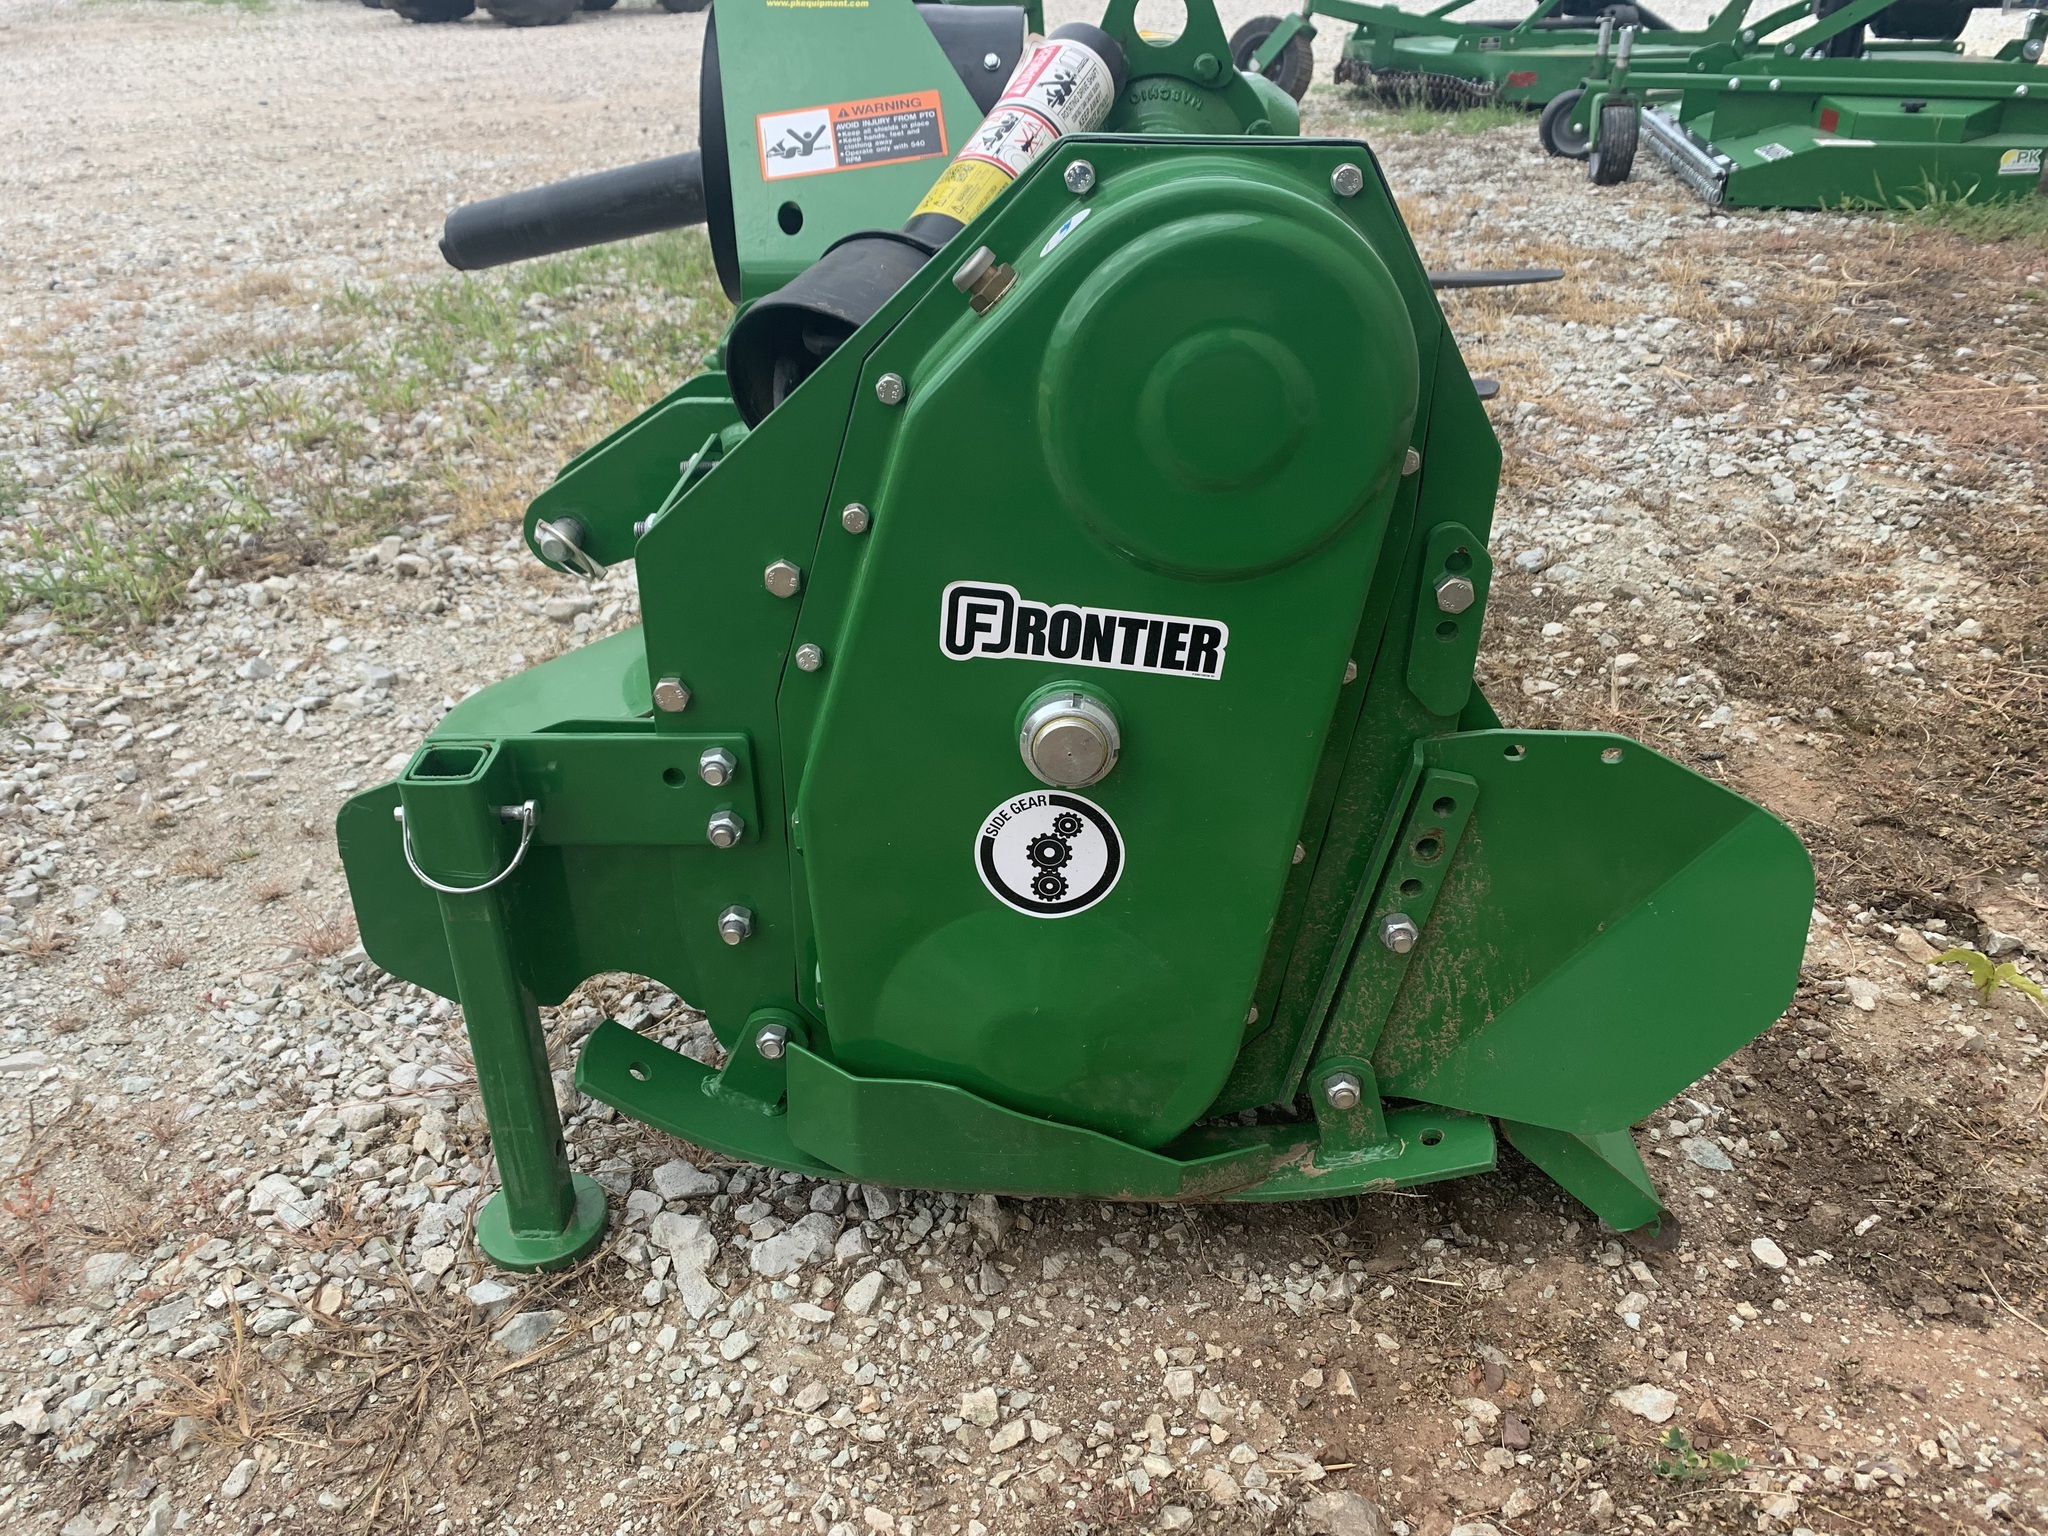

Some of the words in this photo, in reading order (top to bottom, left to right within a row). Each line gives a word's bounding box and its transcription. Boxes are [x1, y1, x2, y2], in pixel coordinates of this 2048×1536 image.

[766, 0, 869, 8] www.pkequipment.com
[851, 97, 922, 116] WARNING
[836, 122, 860, 131] AVOID
[862, 116, 891, 127] INJURY
[893, 113, 917, 122] FROM
[919, 110, 935, 119] PTO
[842, 129, 861, 137] Keep
[874, 123, 899, 133] shields
[910, 120, 930, 130] place
[843, 136, 861, 144] Keep
[890, 129, 904, 137] feet
[907, 128, 920, 136] and
[844, 141, 872, 151] clothing
[874, 139, 893, 147] away
[845, 147, 874, 157] Operate
[876, 145, 891, 153] only
[893, 142, 909, 150] with
[845, 156, 862, 164] RPM
[945, 586, 1222, 674] FRONTIER
[985, 809, 1013, 837] SIDE
[1009, 794, 1047, 815] GEAR
